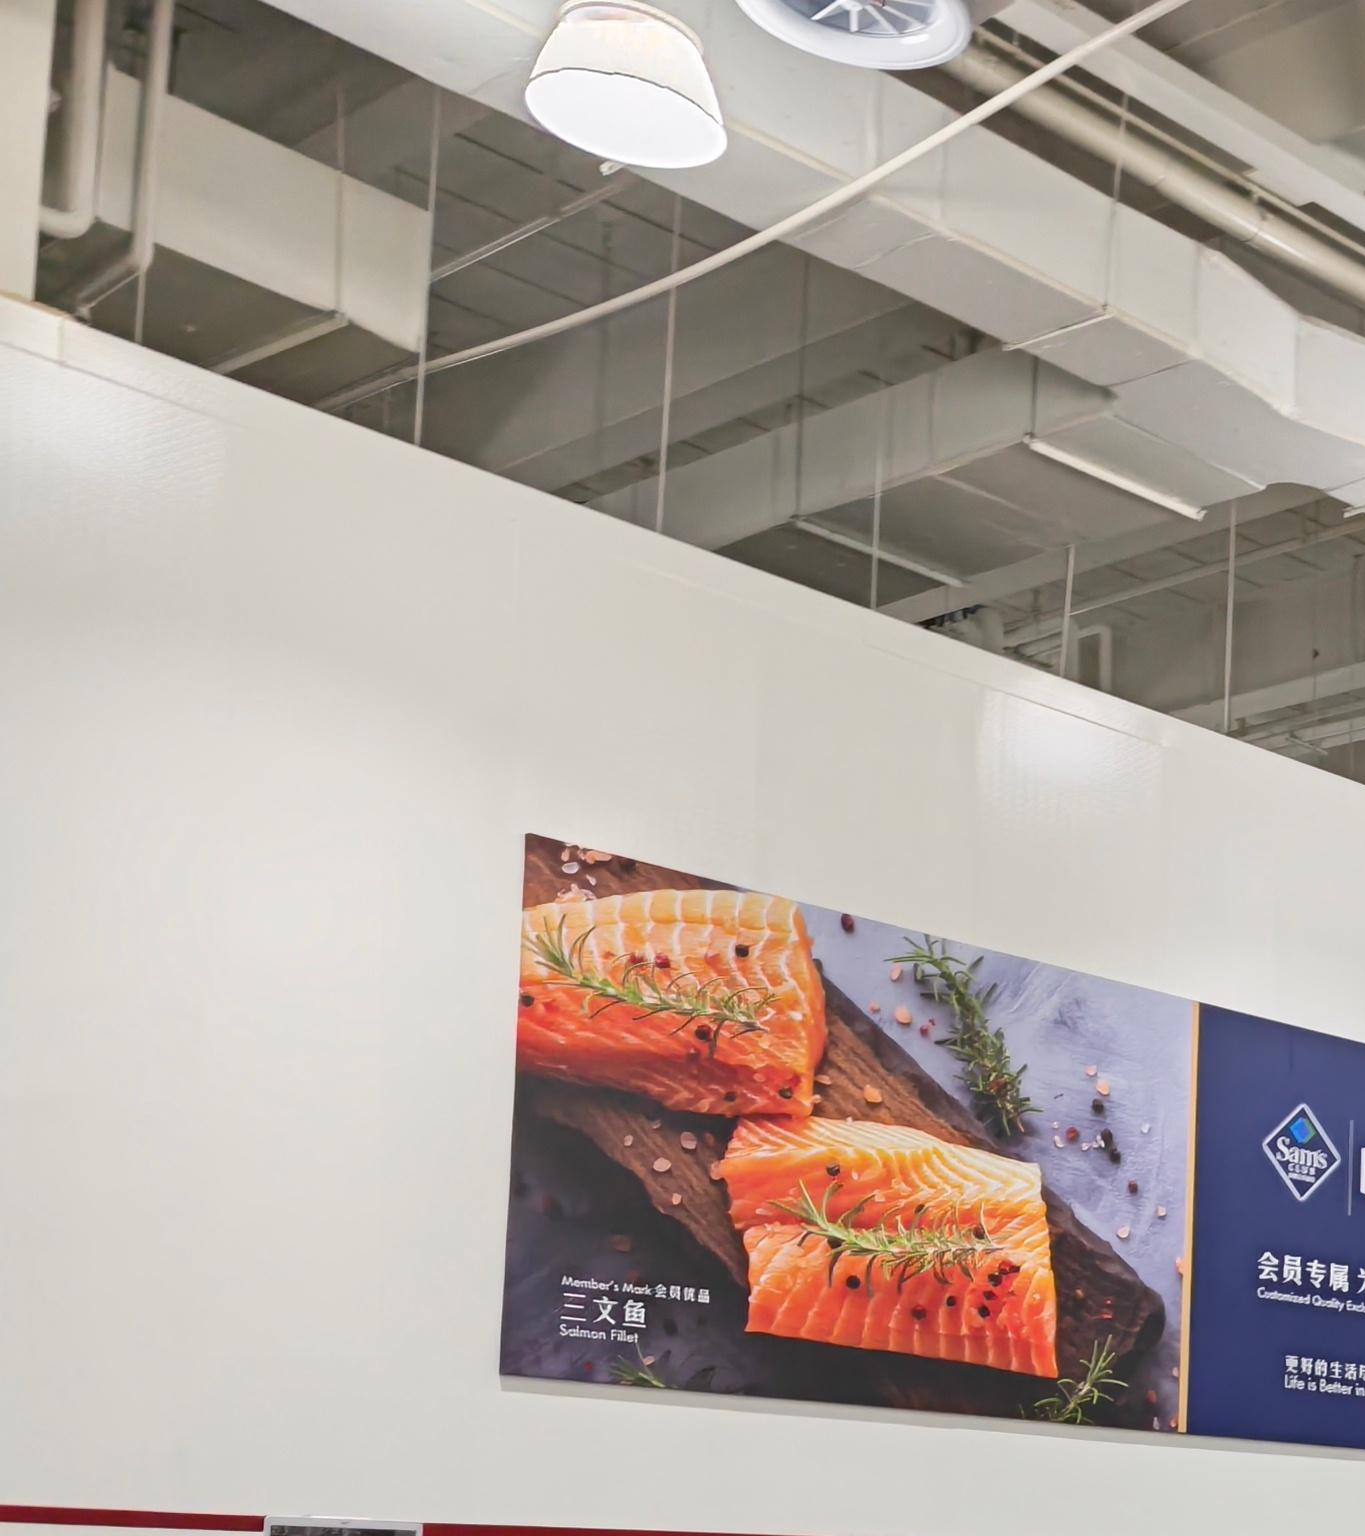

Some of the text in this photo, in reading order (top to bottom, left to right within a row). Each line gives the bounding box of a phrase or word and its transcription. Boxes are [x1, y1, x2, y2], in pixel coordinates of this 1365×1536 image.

[1257, 1250, 1350, 1293] 会员专属
[561, 1274, 619, 1292] Member's
[622, 1282, 653, 1297] Mark
[559, 1292, 647, 1329] 三文鱼
[1256, 1286, 1311, 1306] Customized
[1311, 1294, 1345, 1313] Quality
[559, 1323, 640, 1344] Salmon Fillet
[1284, 1373, 1305, 1391] Life
[1307, 1376, 1317, 1392] is
[1319, 1378, 1353, 1397] Better
[1354, 1382, 1365, 1397] in
